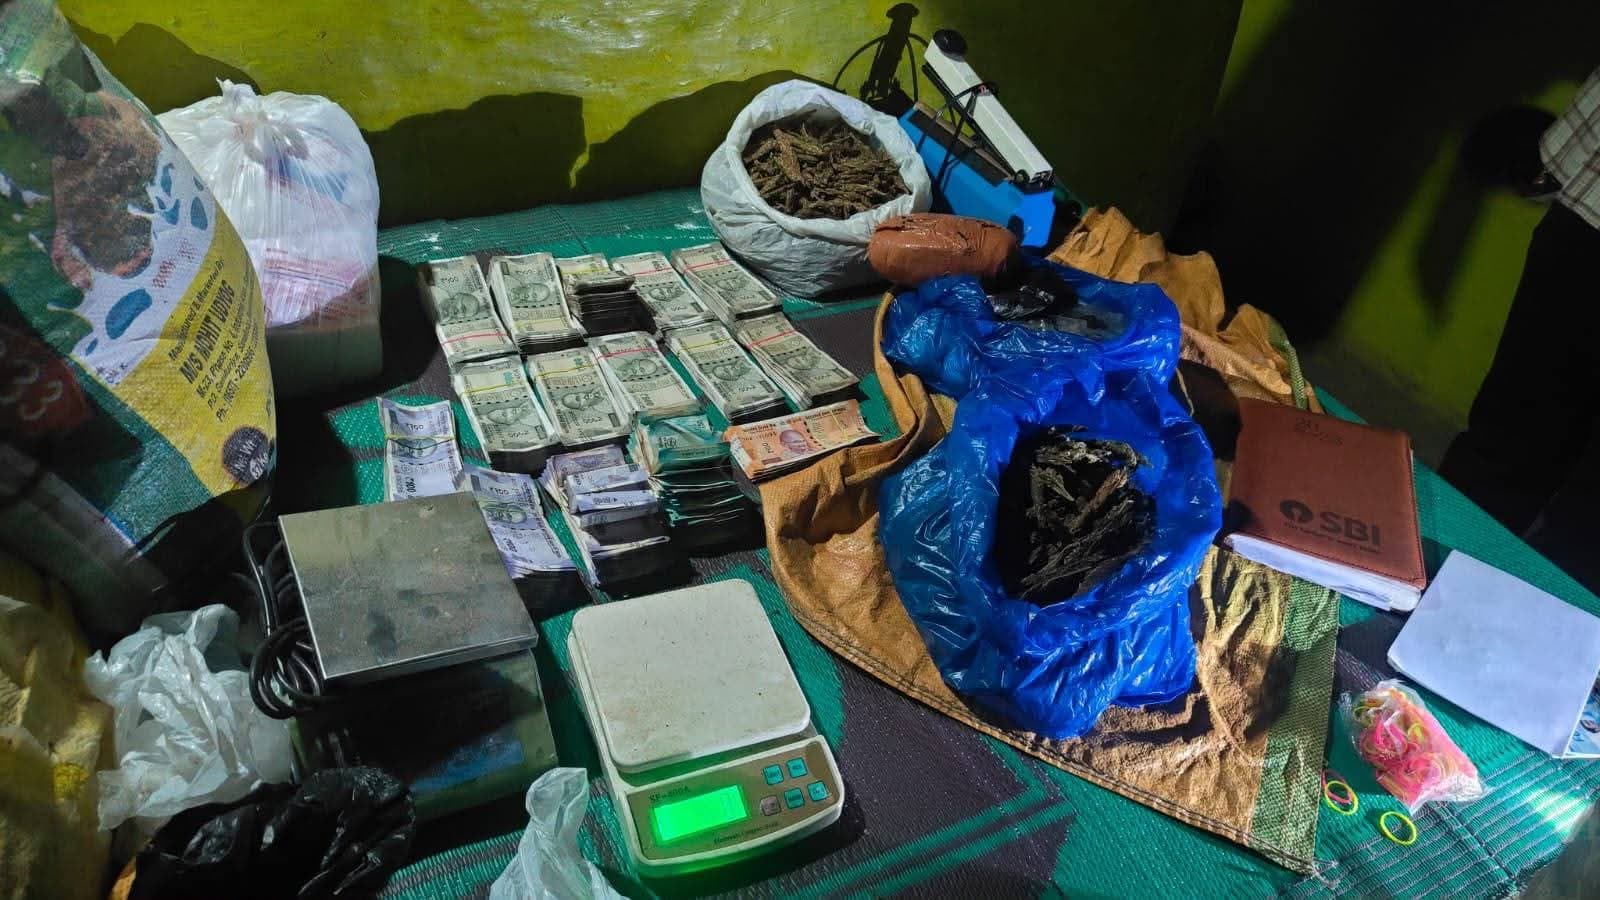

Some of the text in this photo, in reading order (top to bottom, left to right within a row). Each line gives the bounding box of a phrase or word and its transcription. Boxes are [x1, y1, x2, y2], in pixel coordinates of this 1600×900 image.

[179, 279, 235, 384] M/S MOHIT UDYOG
[1320, 511, 1380, 546] SBI
